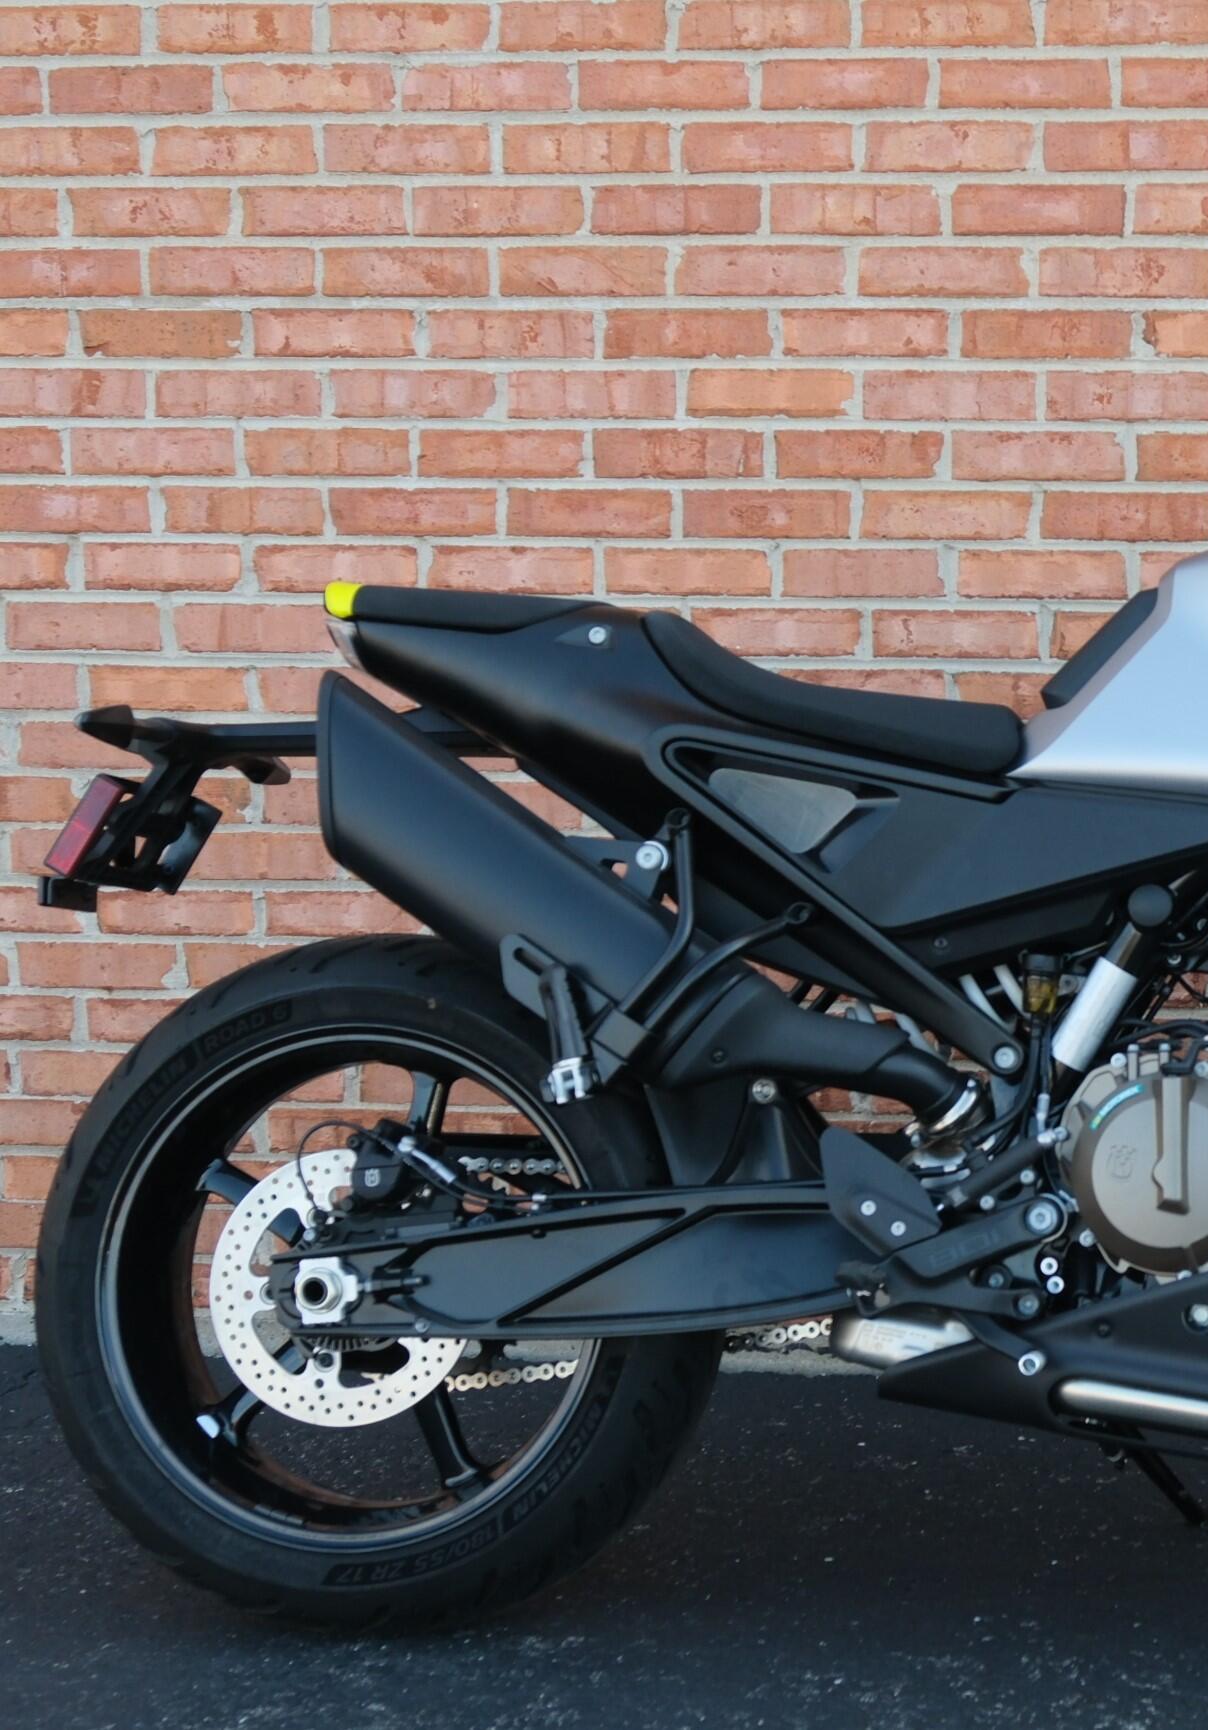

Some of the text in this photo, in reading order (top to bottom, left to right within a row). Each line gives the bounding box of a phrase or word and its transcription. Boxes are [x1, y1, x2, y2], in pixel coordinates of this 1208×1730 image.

[204, 1010, 265, 1052] ROAD
[512, 1404, 602, 1522] MICHELIN
[370, 1560, 407, 1580] ZR
